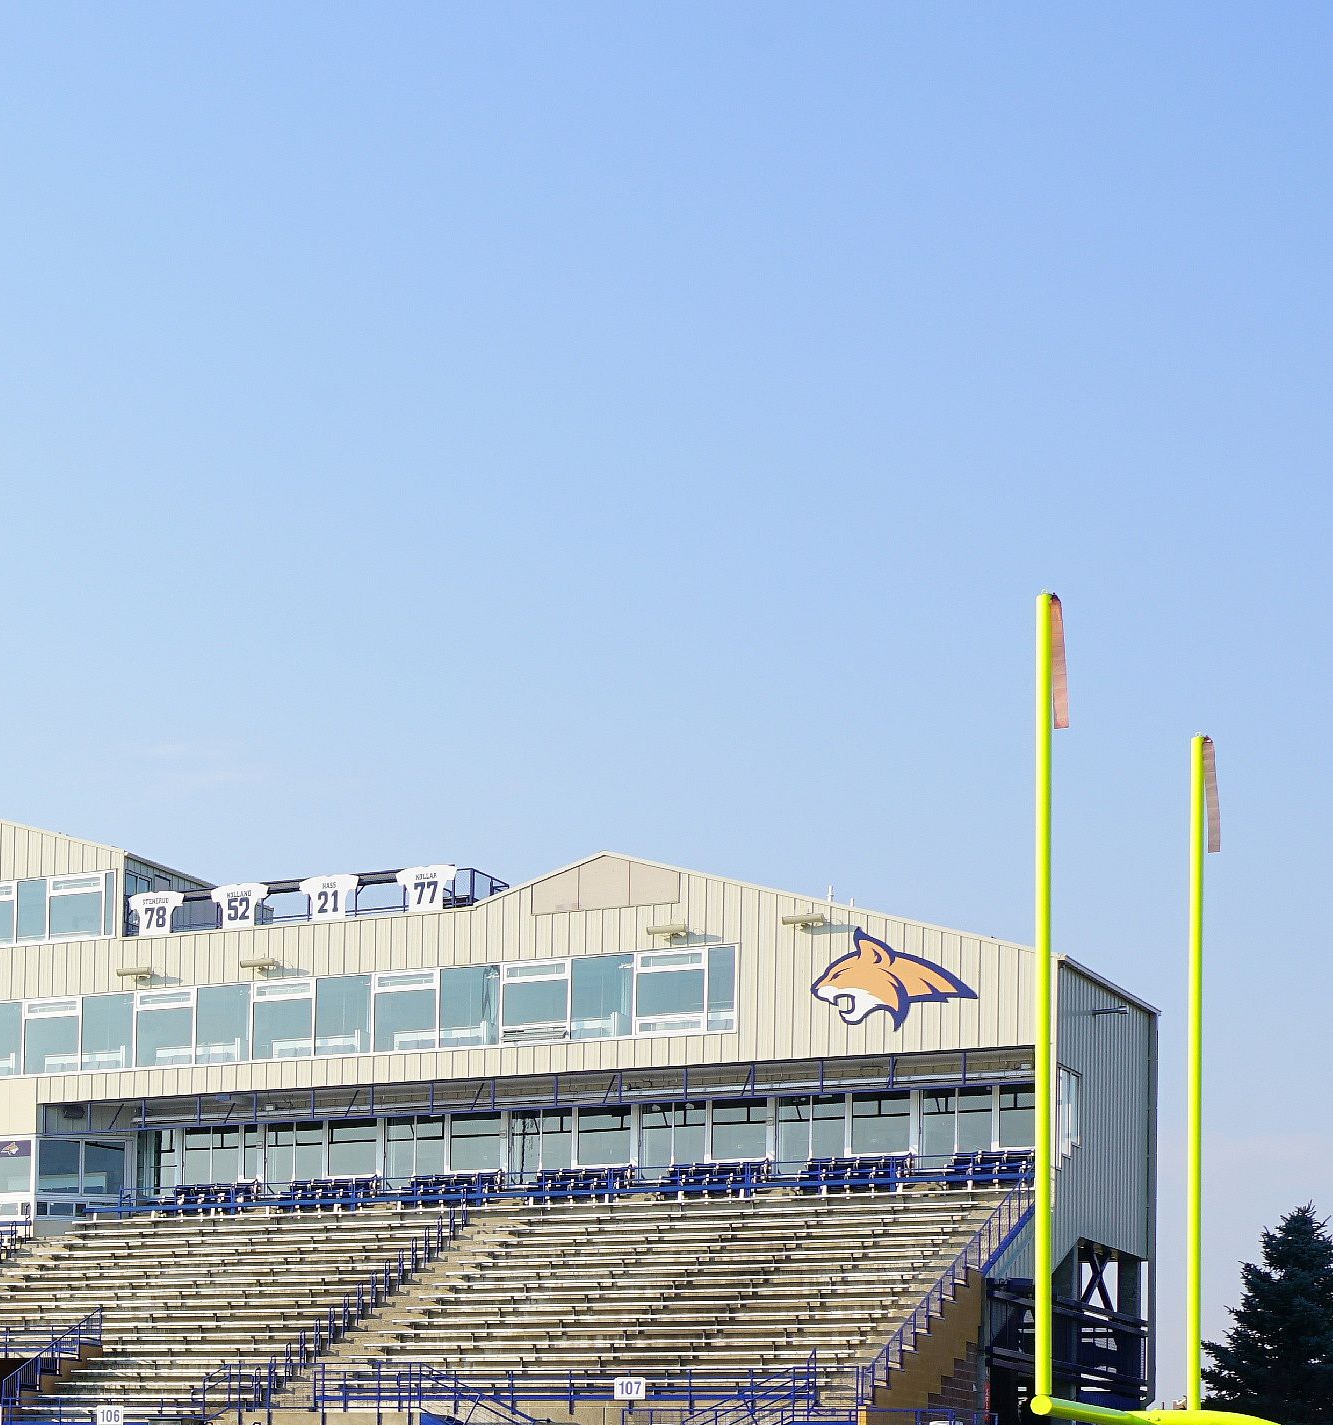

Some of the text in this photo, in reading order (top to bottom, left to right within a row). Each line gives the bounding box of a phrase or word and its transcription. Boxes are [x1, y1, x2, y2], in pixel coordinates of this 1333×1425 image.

[317, 889, 339, 913] 21
[413, 881, 438, 905] 77
[144, 906, 167, 929] 78
[227, 897, 250, 921] 52
[618, 1381, 642, 1395] 107
[100, 1409, 120, 1422] 106
